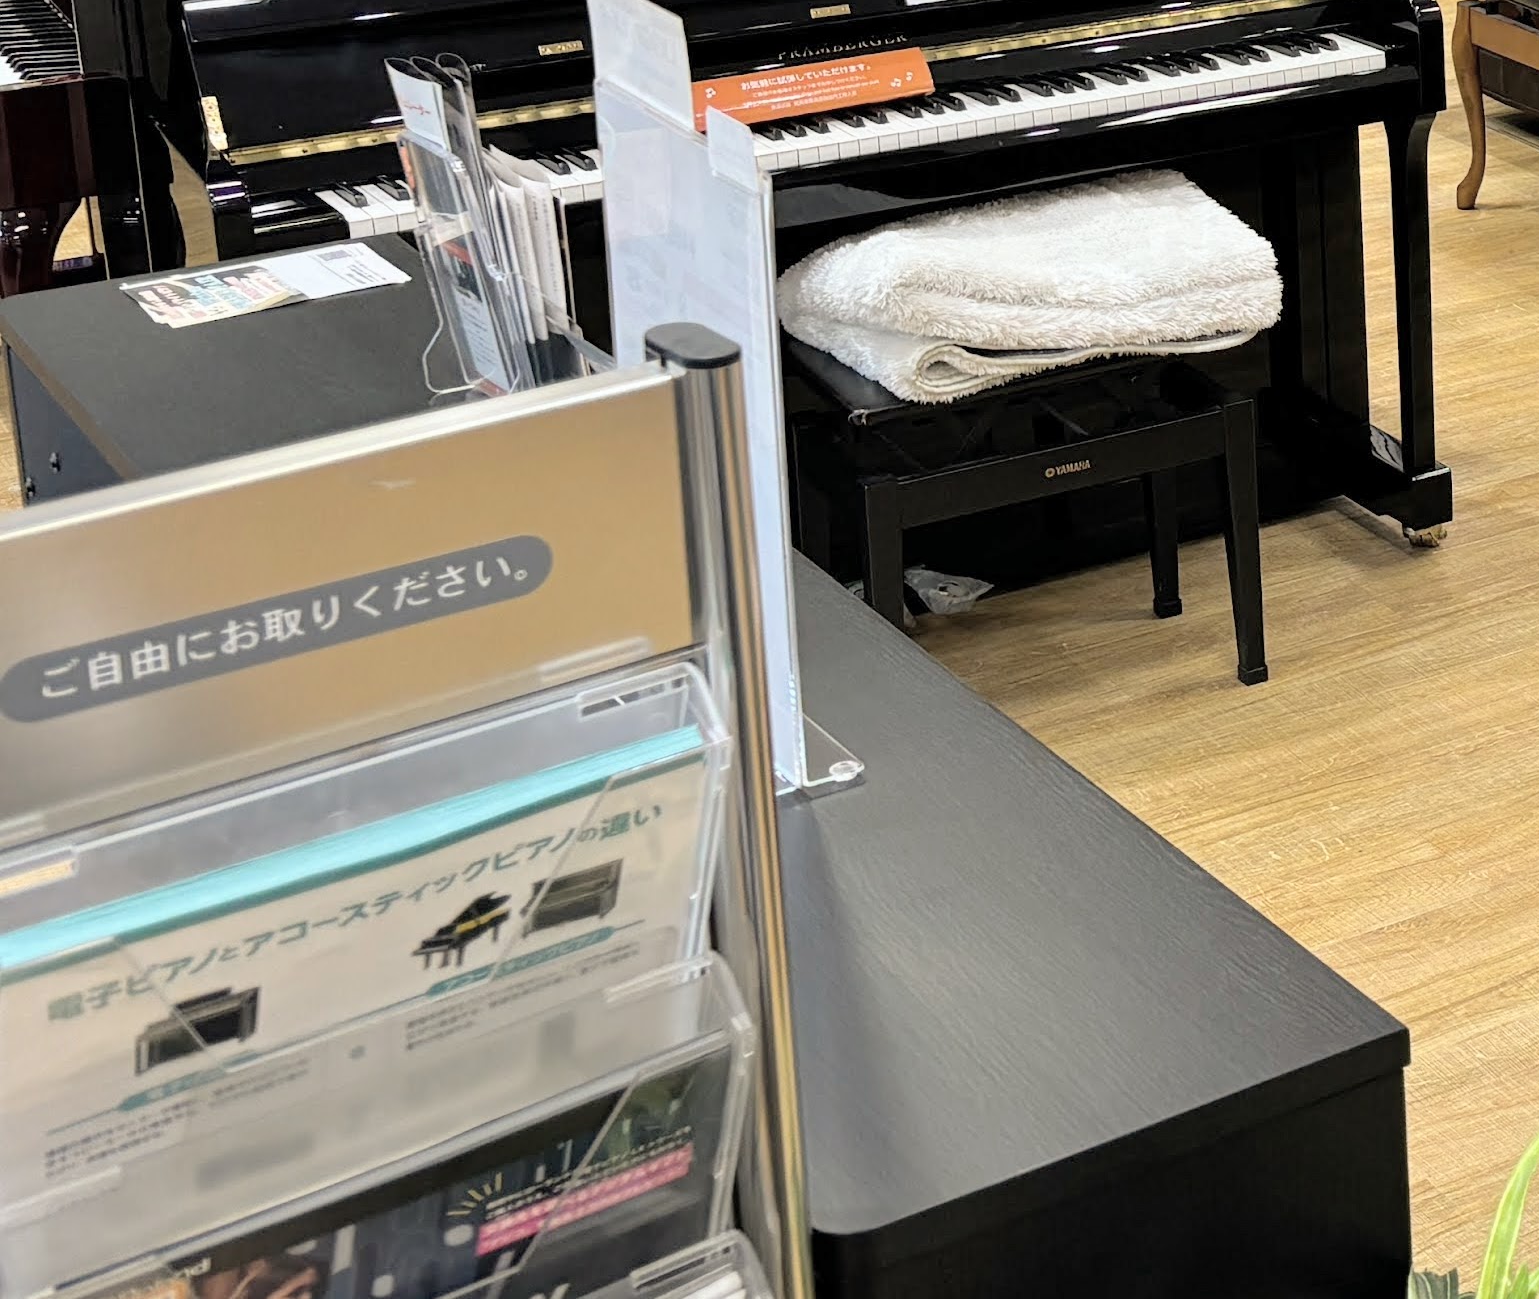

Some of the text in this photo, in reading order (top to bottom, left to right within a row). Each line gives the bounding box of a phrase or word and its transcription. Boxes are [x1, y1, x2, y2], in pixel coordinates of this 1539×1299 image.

[40, 552, 531, 702] ご自由にお取りください。
[48, 802, 663, 1026] 電子ピアノとアコースティックピアノの違い
